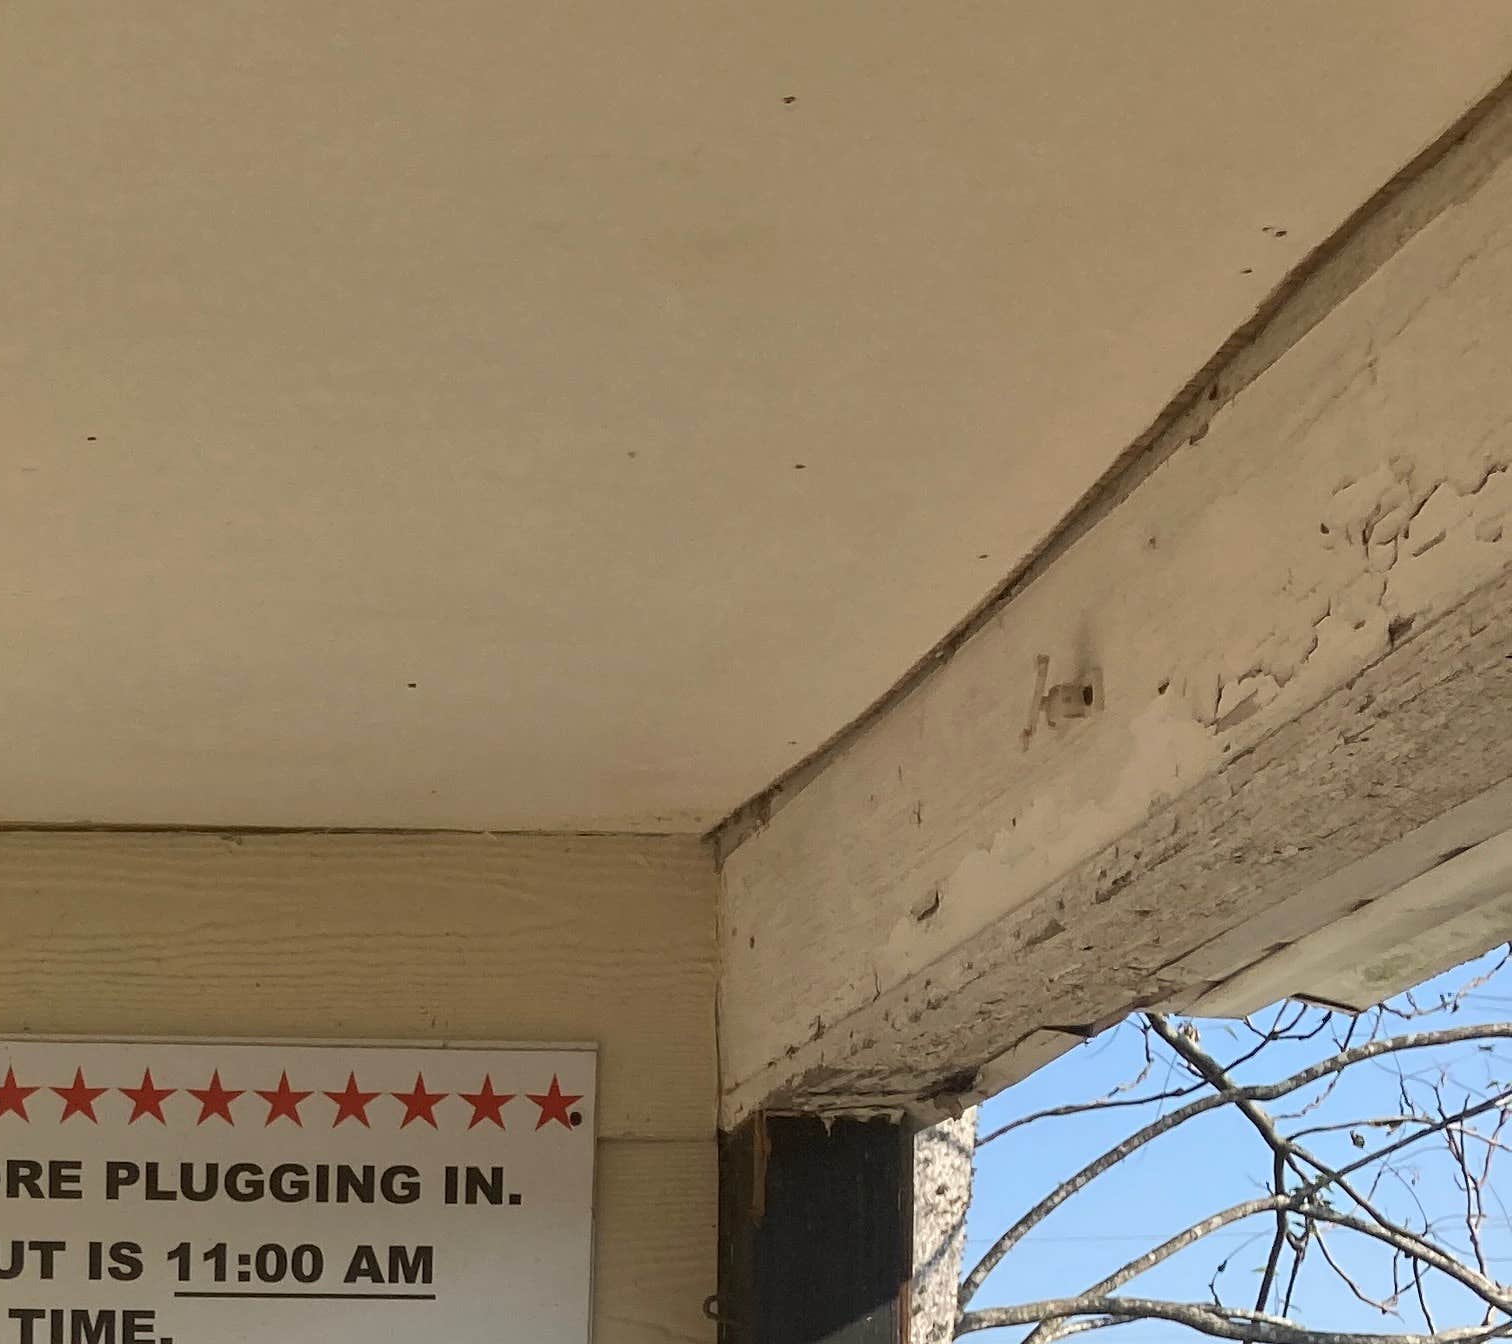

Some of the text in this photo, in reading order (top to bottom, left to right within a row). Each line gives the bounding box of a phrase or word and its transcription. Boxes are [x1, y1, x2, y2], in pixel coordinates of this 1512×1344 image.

[106, 1162, 420, 1204] PLUGGING
[445, 1166, 521, 1205] IN.
[89, 1242, 143, 1281] IS
[168, 1242, 323, 1283] 11:00
[344, 1245, 433, 1284] AM
